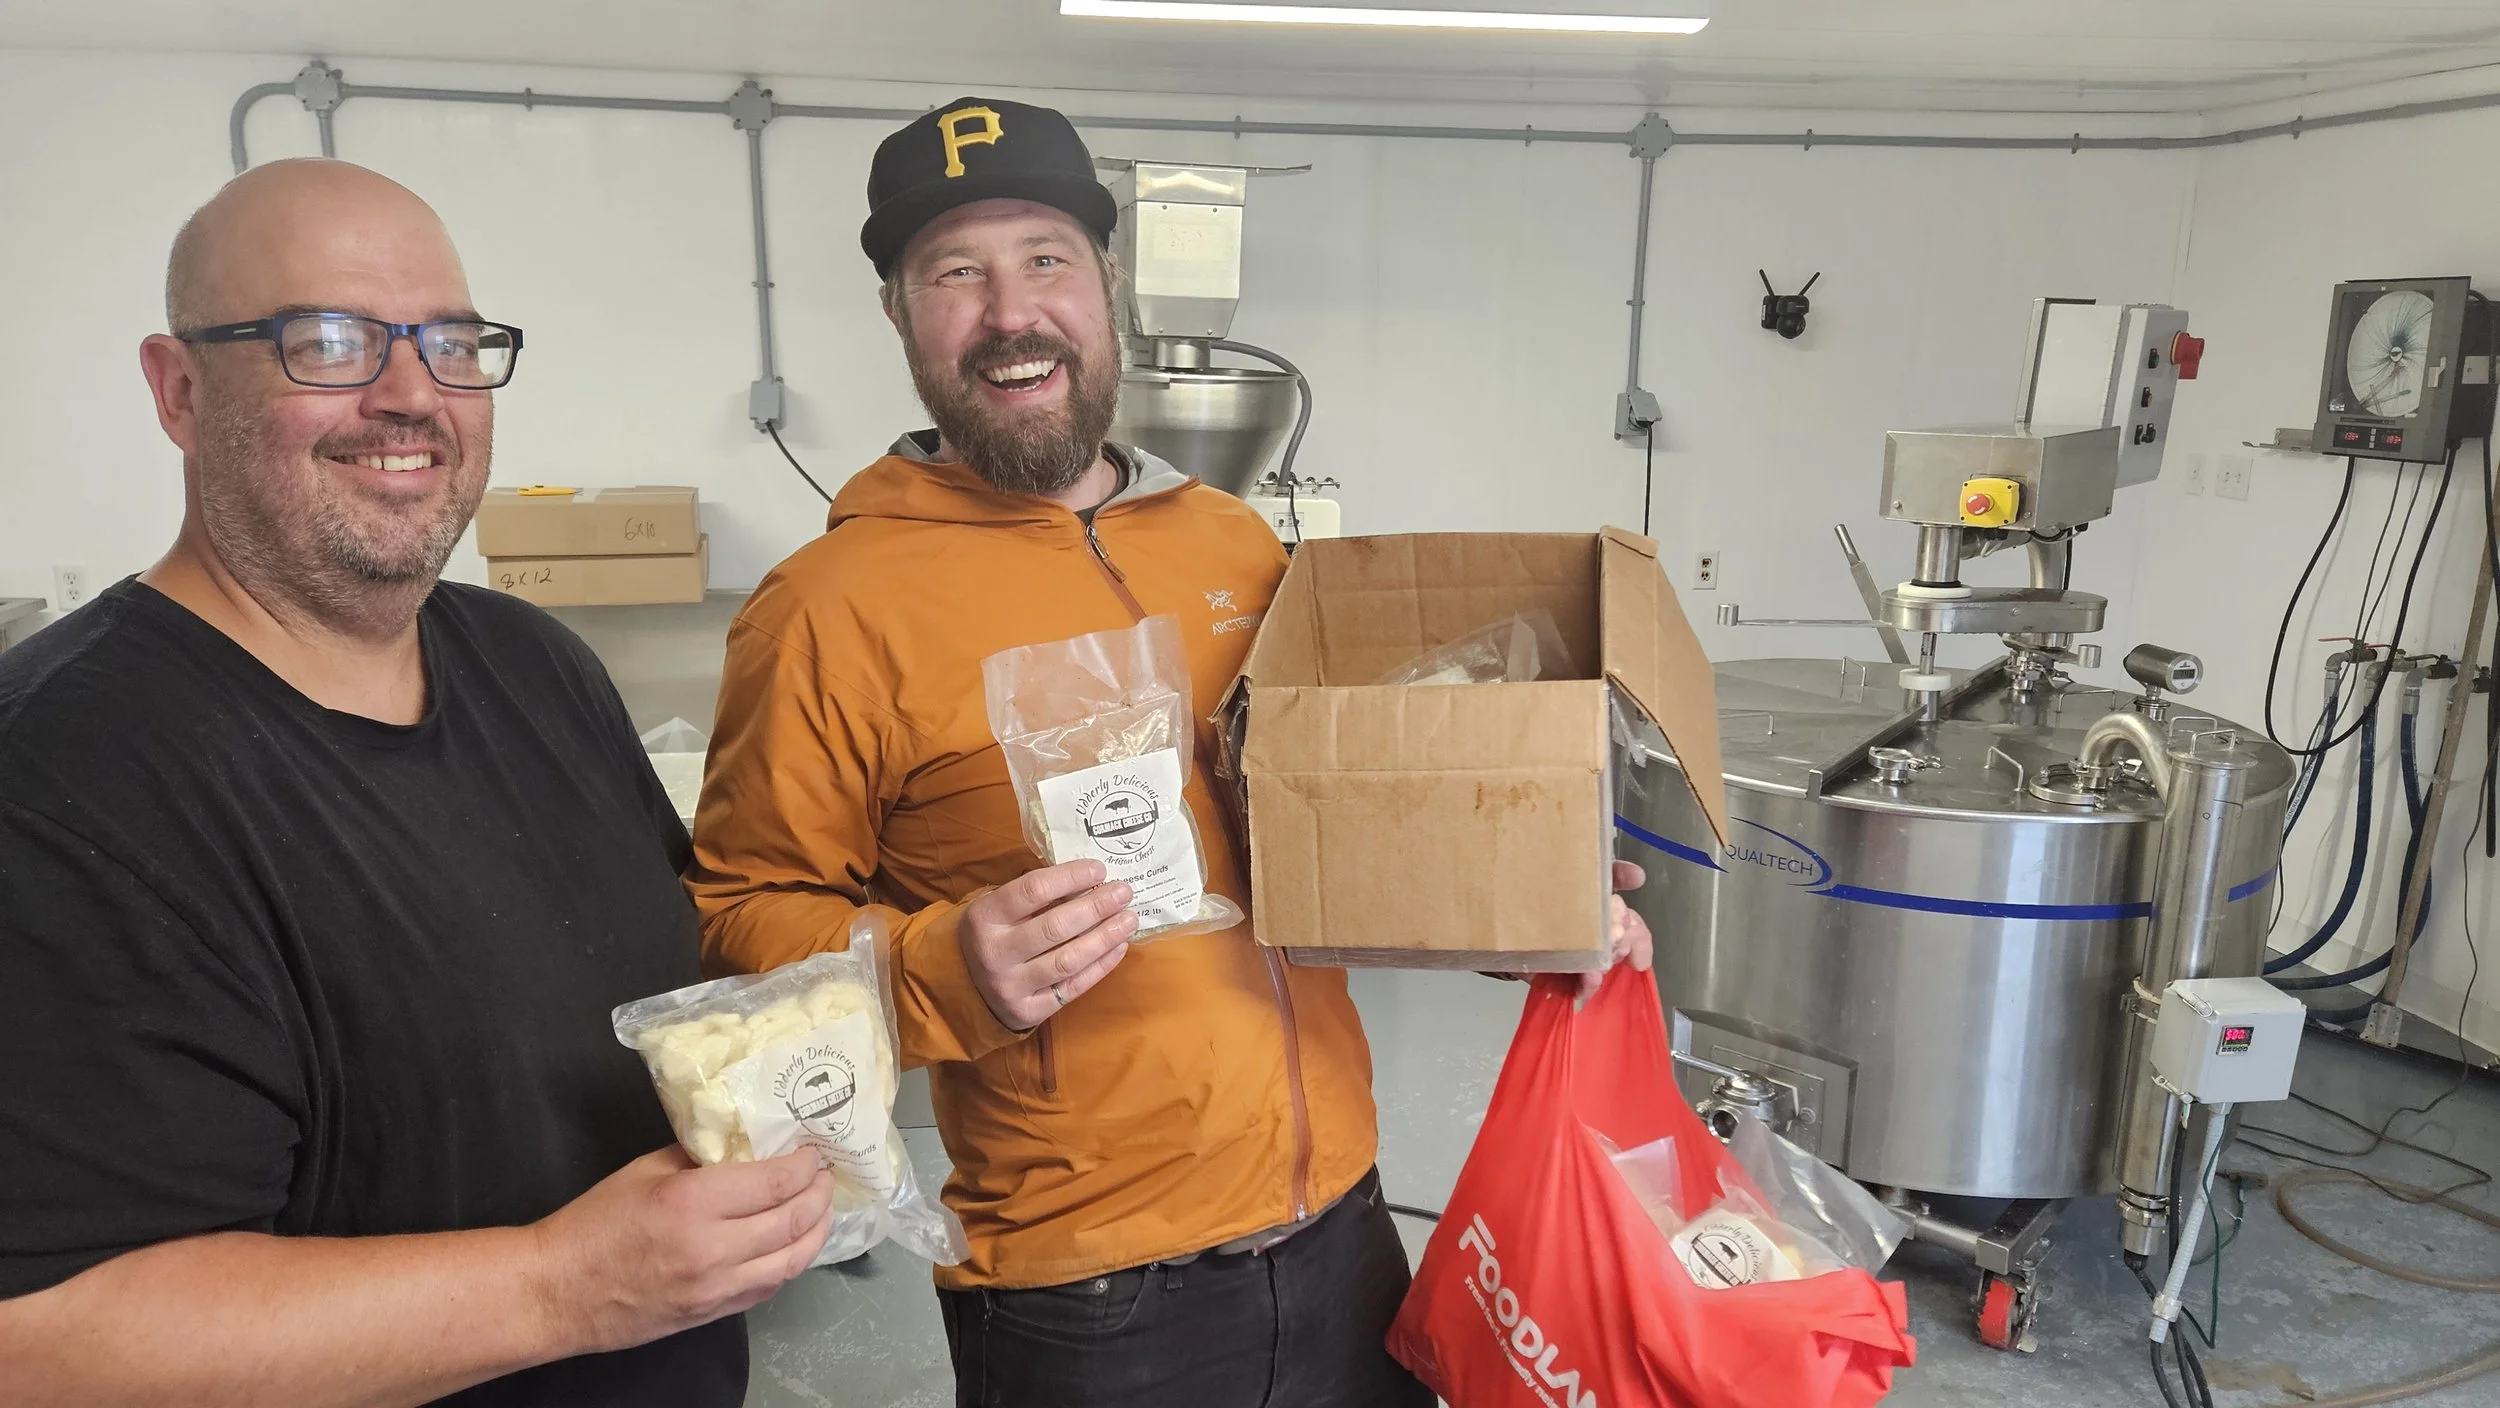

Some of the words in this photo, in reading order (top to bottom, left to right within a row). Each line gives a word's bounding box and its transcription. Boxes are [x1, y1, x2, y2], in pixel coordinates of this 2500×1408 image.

[936, 105, 1004, 178] P
[1075, 778, 1109, 815] Udderly
[1112, 774, 1159, 800] Delicious
[1104, 855, 1133, 866] Artisan
[1134, 845, 1155, 863] Cheese
[1146, 863, 1169, 878] Curds
[1725, 844, 1813, 876] QUALTECH
[773, 1054, 805, 1098] Udderly
[805, 1044, 856, 1071] Delicious
[849, 1143, 877, 1157] Curds
[1741, 1234, 1761, 1281] Delicious
[1464, 1275, 1486, 1311] Fresh
